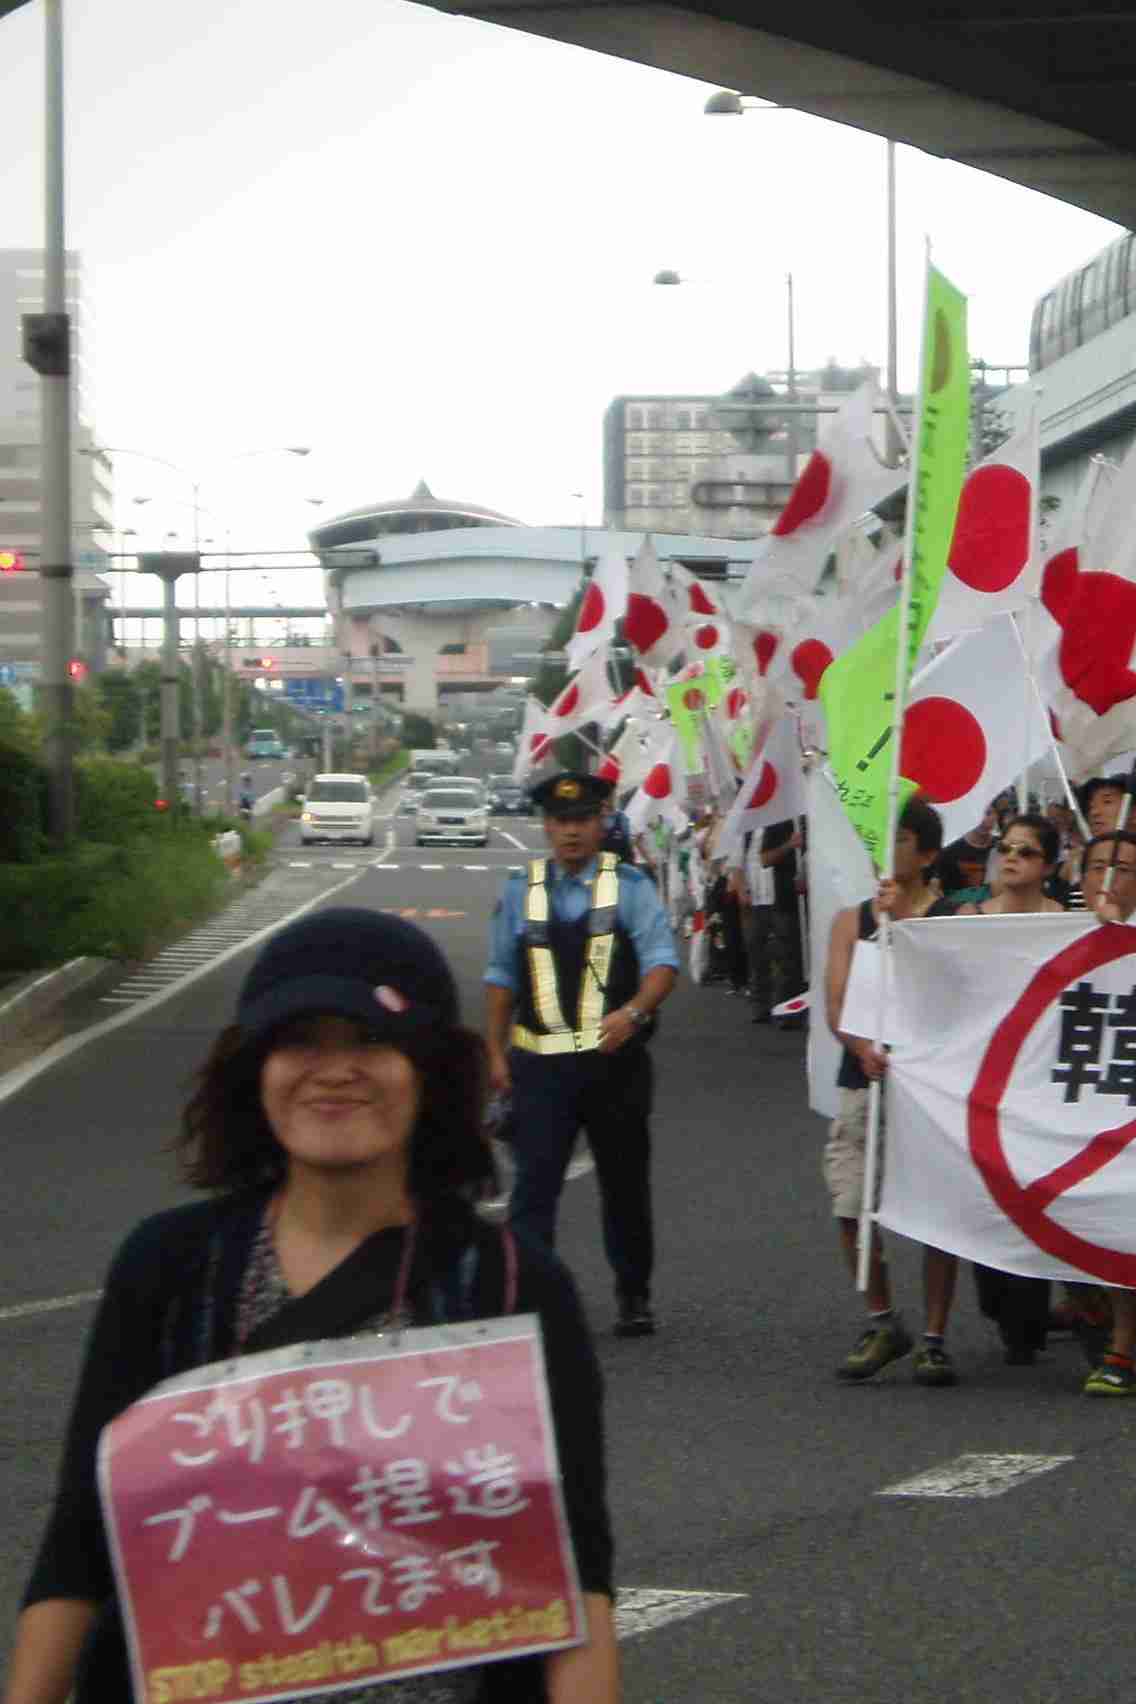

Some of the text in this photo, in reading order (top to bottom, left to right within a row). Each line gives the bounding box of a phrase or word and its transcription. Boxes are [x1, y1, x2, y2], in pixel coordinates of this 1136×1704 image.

[170, 1374, 485, 1467] ごり押しで
[142, 1443, 530, 1562] ブーム捏造
[203, 1538, 503, 1639] バレてます
[149, 1656, 232, 1704] STOP
